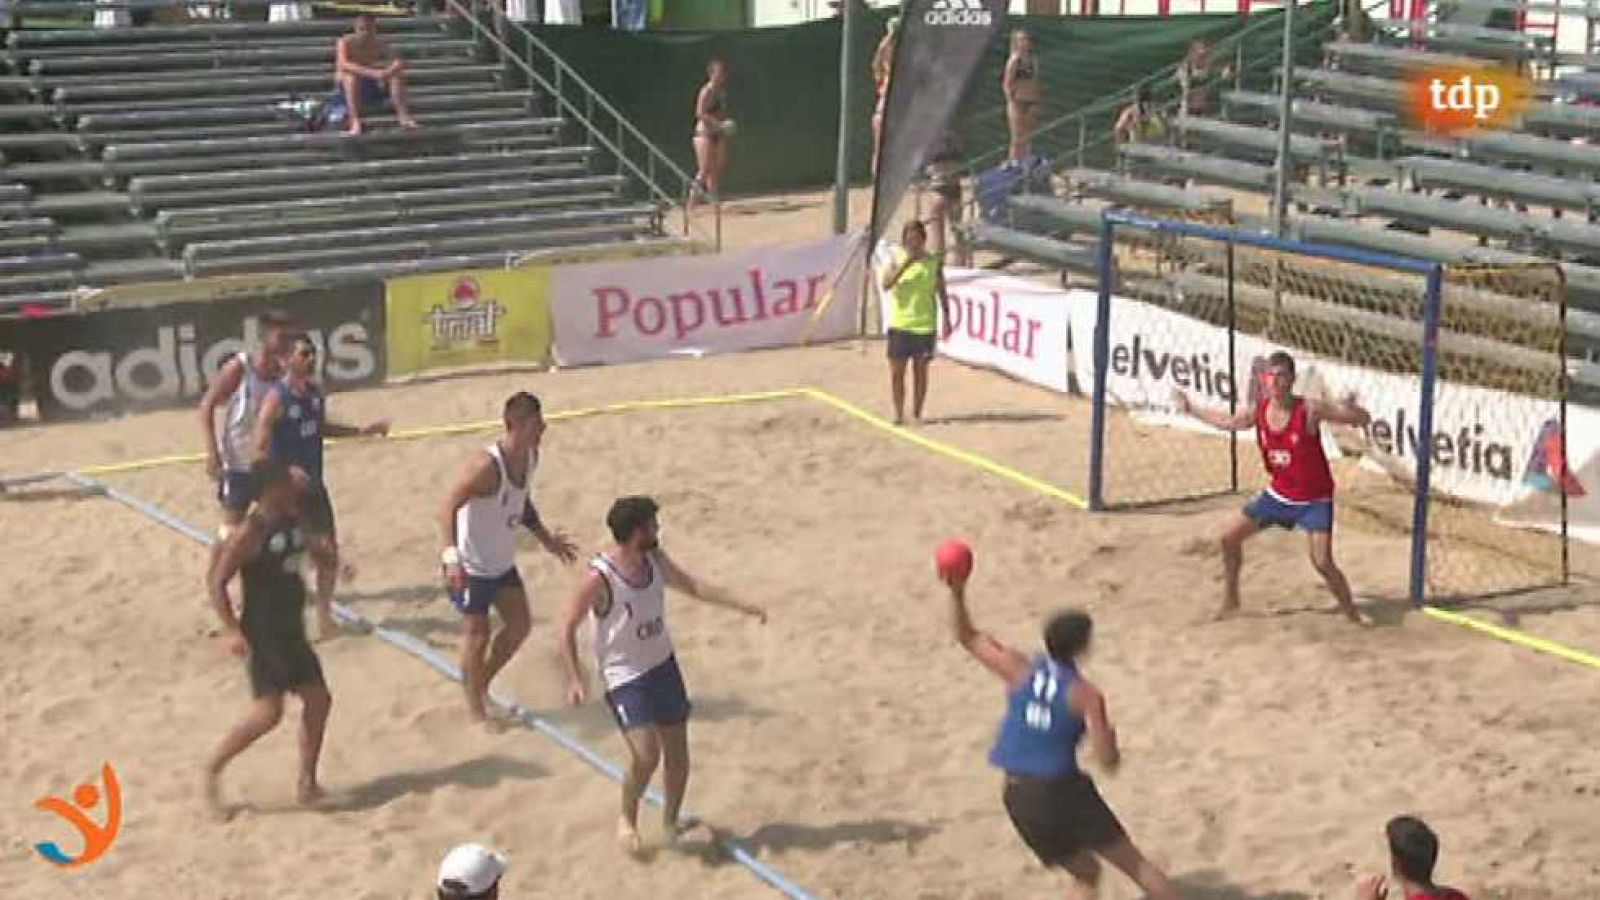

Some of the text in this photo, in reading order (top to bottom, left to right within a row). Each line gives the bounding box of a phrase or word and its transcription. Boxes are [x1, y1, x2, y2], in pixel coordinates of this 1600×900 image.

[924, 8, 991, 25] adidas
[593, 267, 827, 341] Popular
[941, 291, 1042, 358] pular
[1110, 334, 1236, 400] elvetia
[1364, 407, 1513, 480] elvetia
